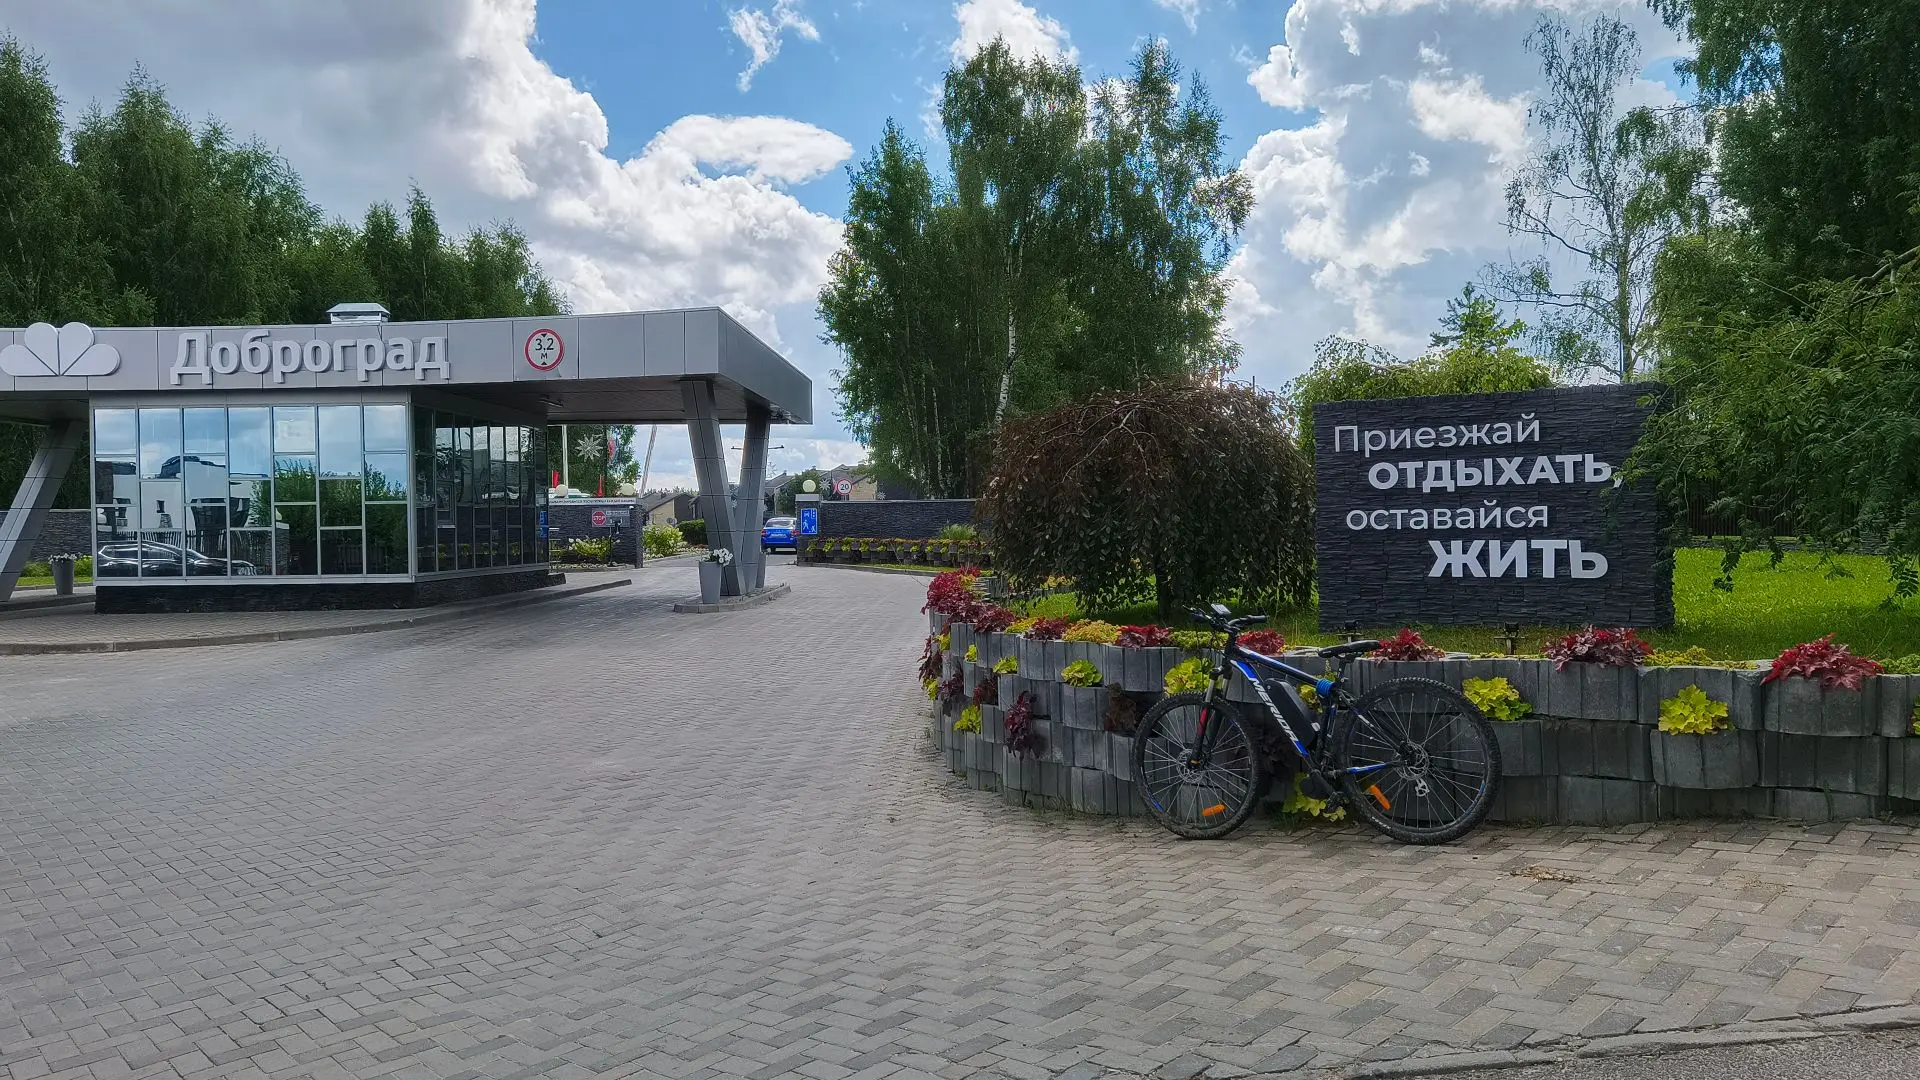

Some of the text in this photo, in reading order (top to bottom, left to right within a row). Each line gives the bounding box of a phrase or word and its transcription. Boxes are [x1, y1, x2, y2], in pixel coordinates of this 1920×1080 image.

[170, 330, 450, 385] Доброград
[1334, 413, 1541, 457] Приезжай
[1346, 500, 1548, 530] оставайся
[1428, 539, 1609, 579] ЖИТЬ
[1252, 679, 1299, 742] MERIDA
